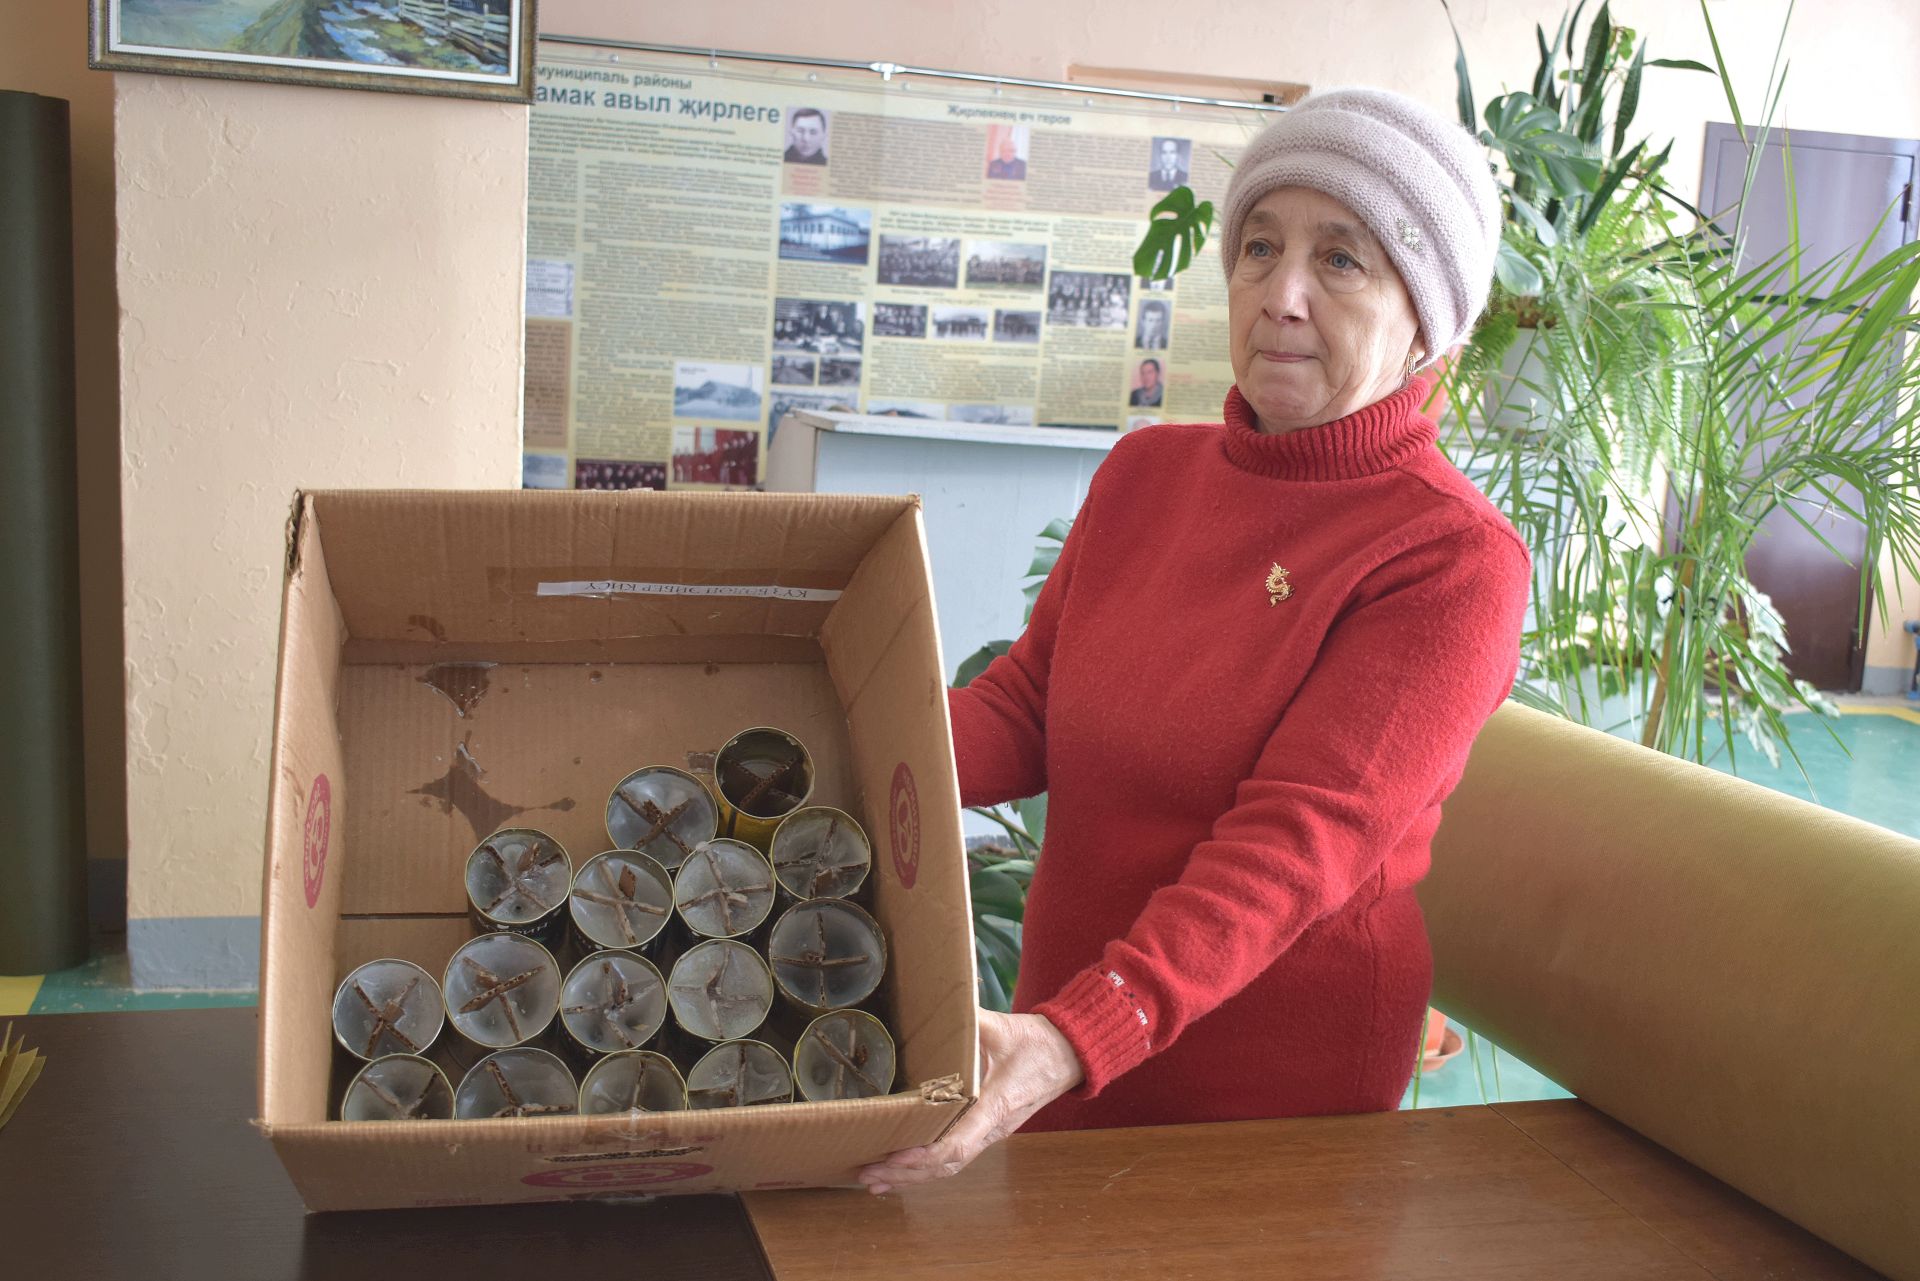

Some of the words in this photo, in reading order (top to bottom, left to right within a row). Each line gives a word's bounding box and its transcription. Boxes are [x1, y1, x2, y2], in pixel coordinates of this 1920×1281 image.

[536, 65, 630, 85] муниципаль
[633, 73, 693, 90] районы
[535, 85, 596, 106] амак
[603, 89, 671, 113] авыл
[679, 98, 781, 124] җирлеге
